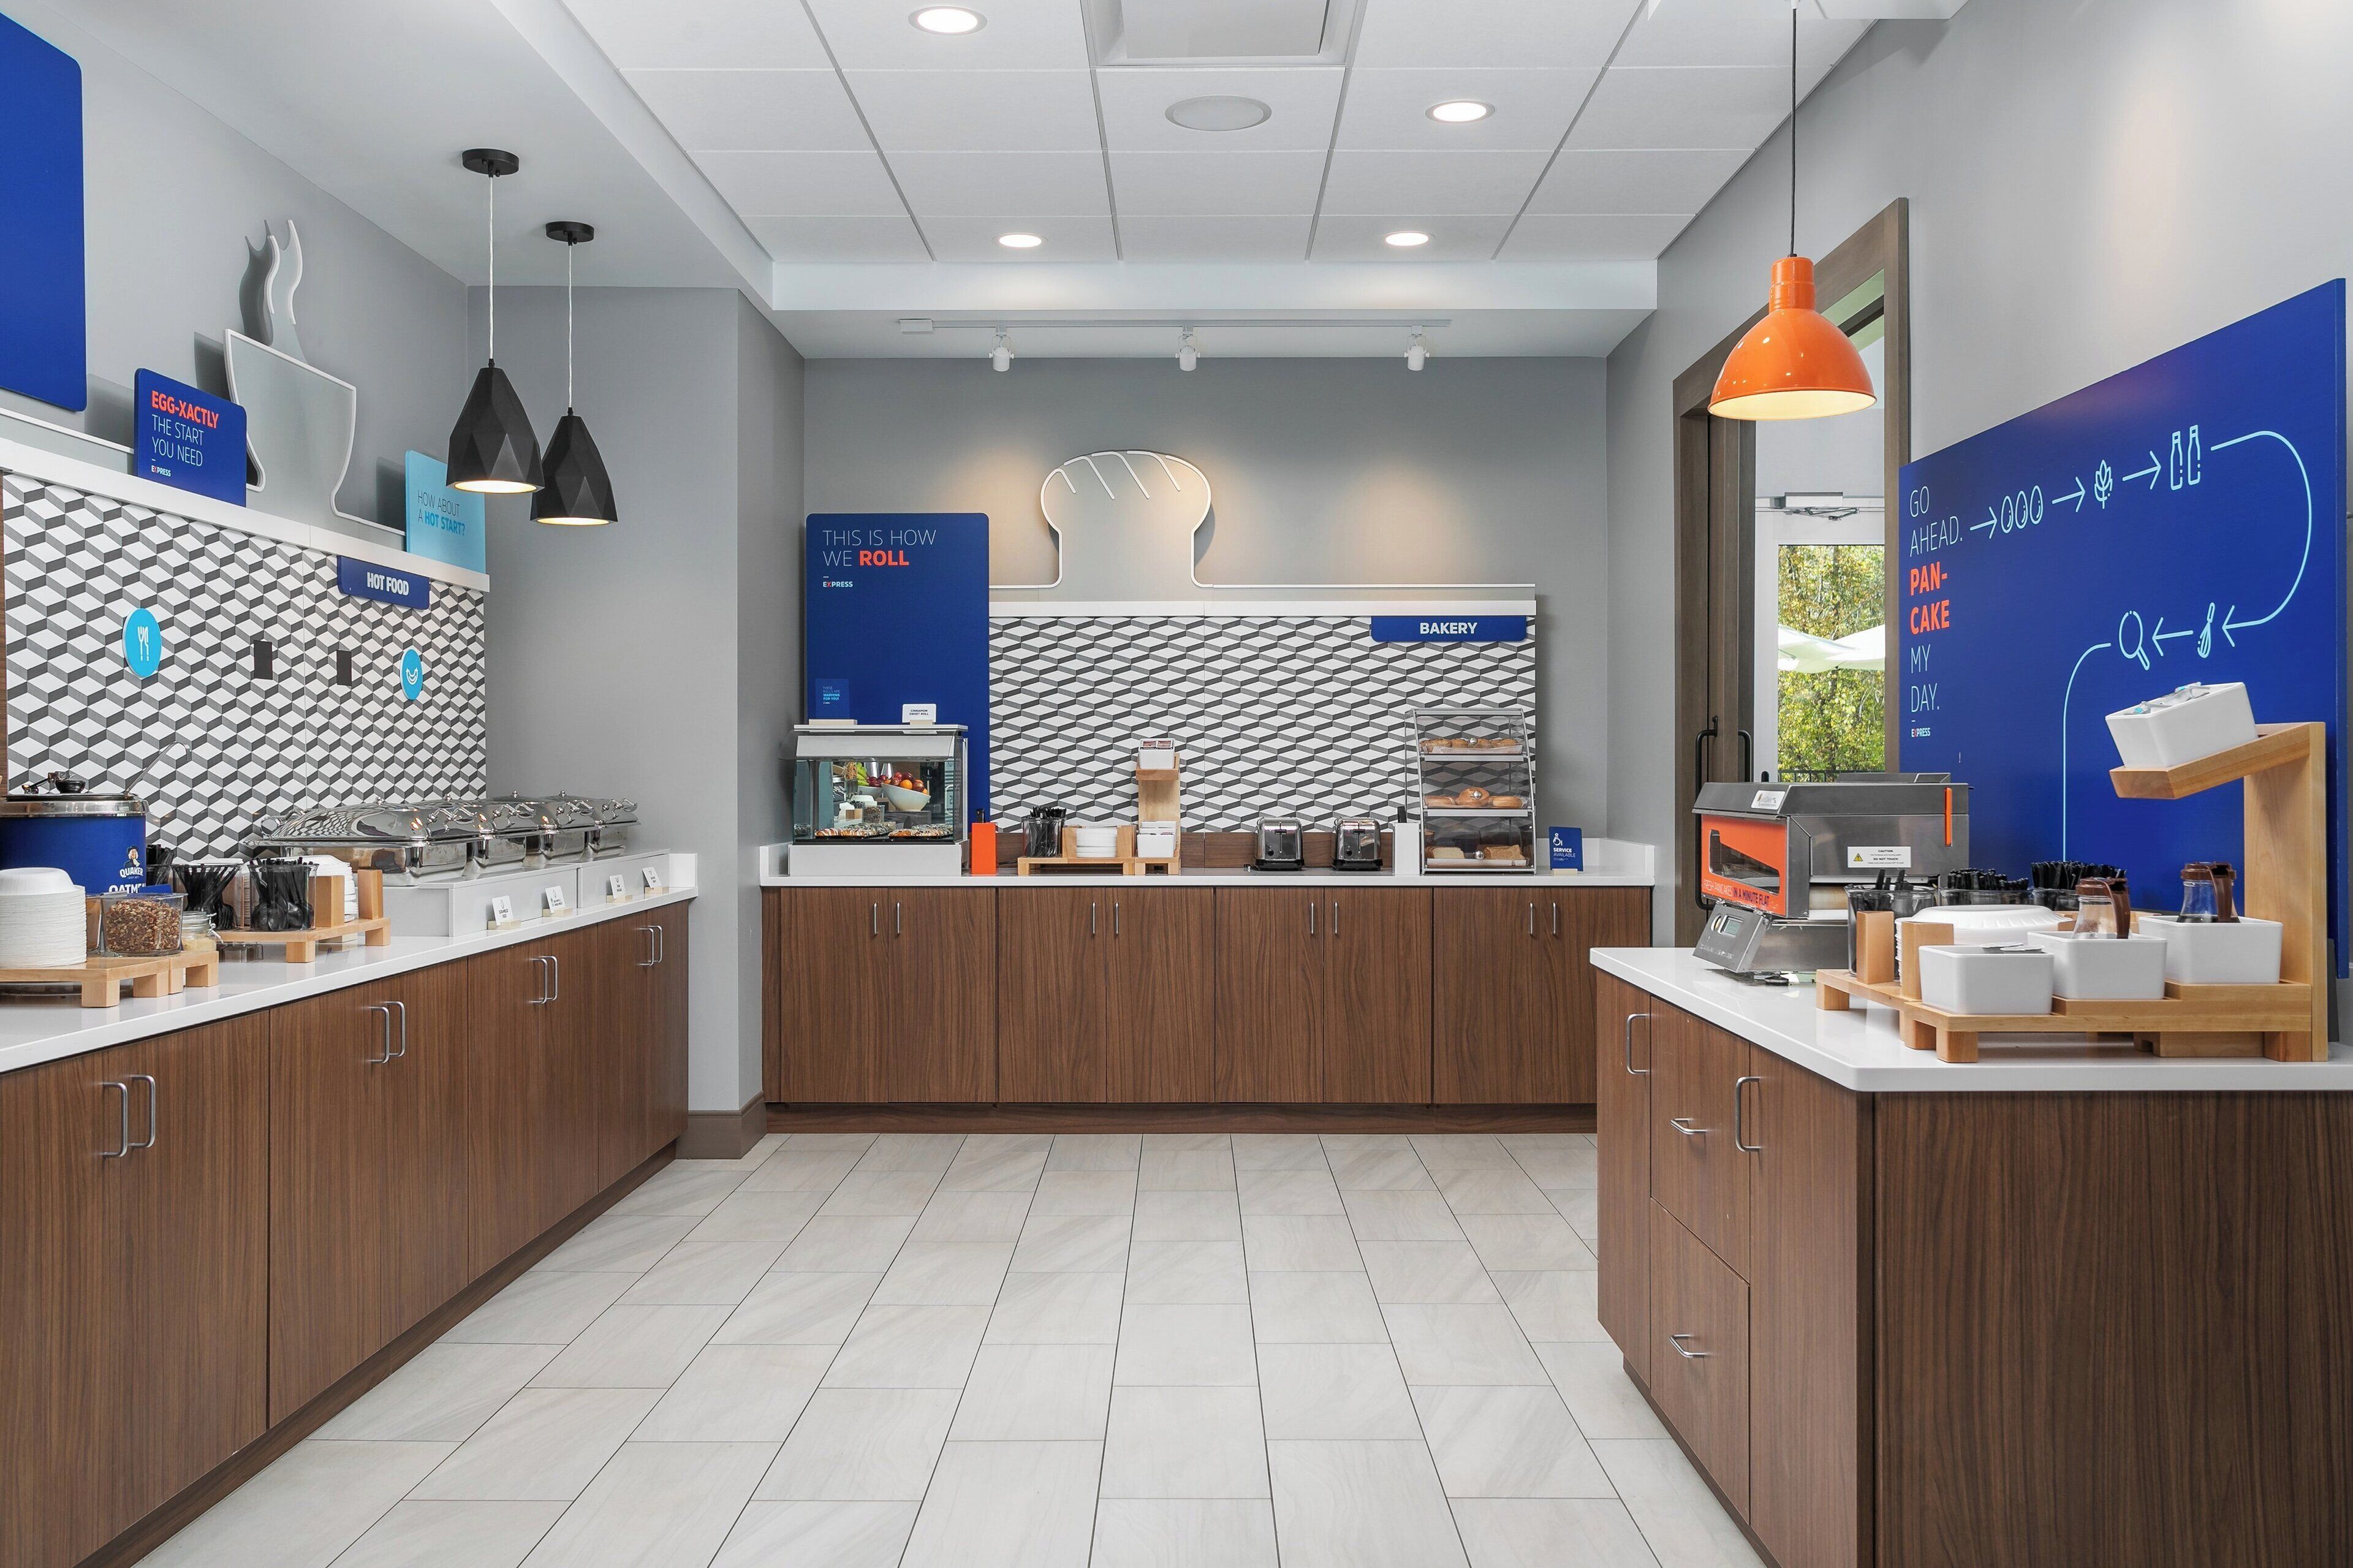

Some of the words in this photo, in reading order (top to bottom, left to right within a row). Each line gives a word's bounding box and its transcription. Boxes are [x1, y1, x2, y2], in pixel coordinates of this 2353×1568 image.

[151, 390, 219, 429] EGG-XACTLY
[152, 414, 172, 436] THE
[175, 422, 204, 446] START
[152, 436, 174, 458] YOU
[177, 444, 203, 466] NEED
[151, 465, 171, 477] EXPRESS
[418, 490, 435, 509] HOW
[438, 498, 460, 517] ABOUT
[1910, 486, 1930, 518] GO
[418, 509, 423, 522] A
[425, 510, 439, 528] HOT
[441, 516, 465, 536] START?
[1910, 515, 1963, 557] AHEAD.
[822, 529, 862, 546] THIS
[870, 529, 883, 546] IS
[890, 529, 936, 545] HOW
[822, 550, 852, 567] WE
[859, 550, 909, 566] ROLL
[366, 572, 385, 590] HOT
[386, 577, 409, 596] FOOD
[1910, 561, 1947, 596] PAN-
[1420, 622, 1477, 634] BAKERY
[1910, 599, 1950, 635] CAKE
[1911, 644, 1931, 673] MY
[1911, 683, 1939, 713] DAY.
[1911, 727, 1931, 737] EXPRESS
[119, 867, 144, 878] QUAKER
[1743, 889, 1758, 904] MINUTE
[1759, 894, 1770, 906] FLAT
